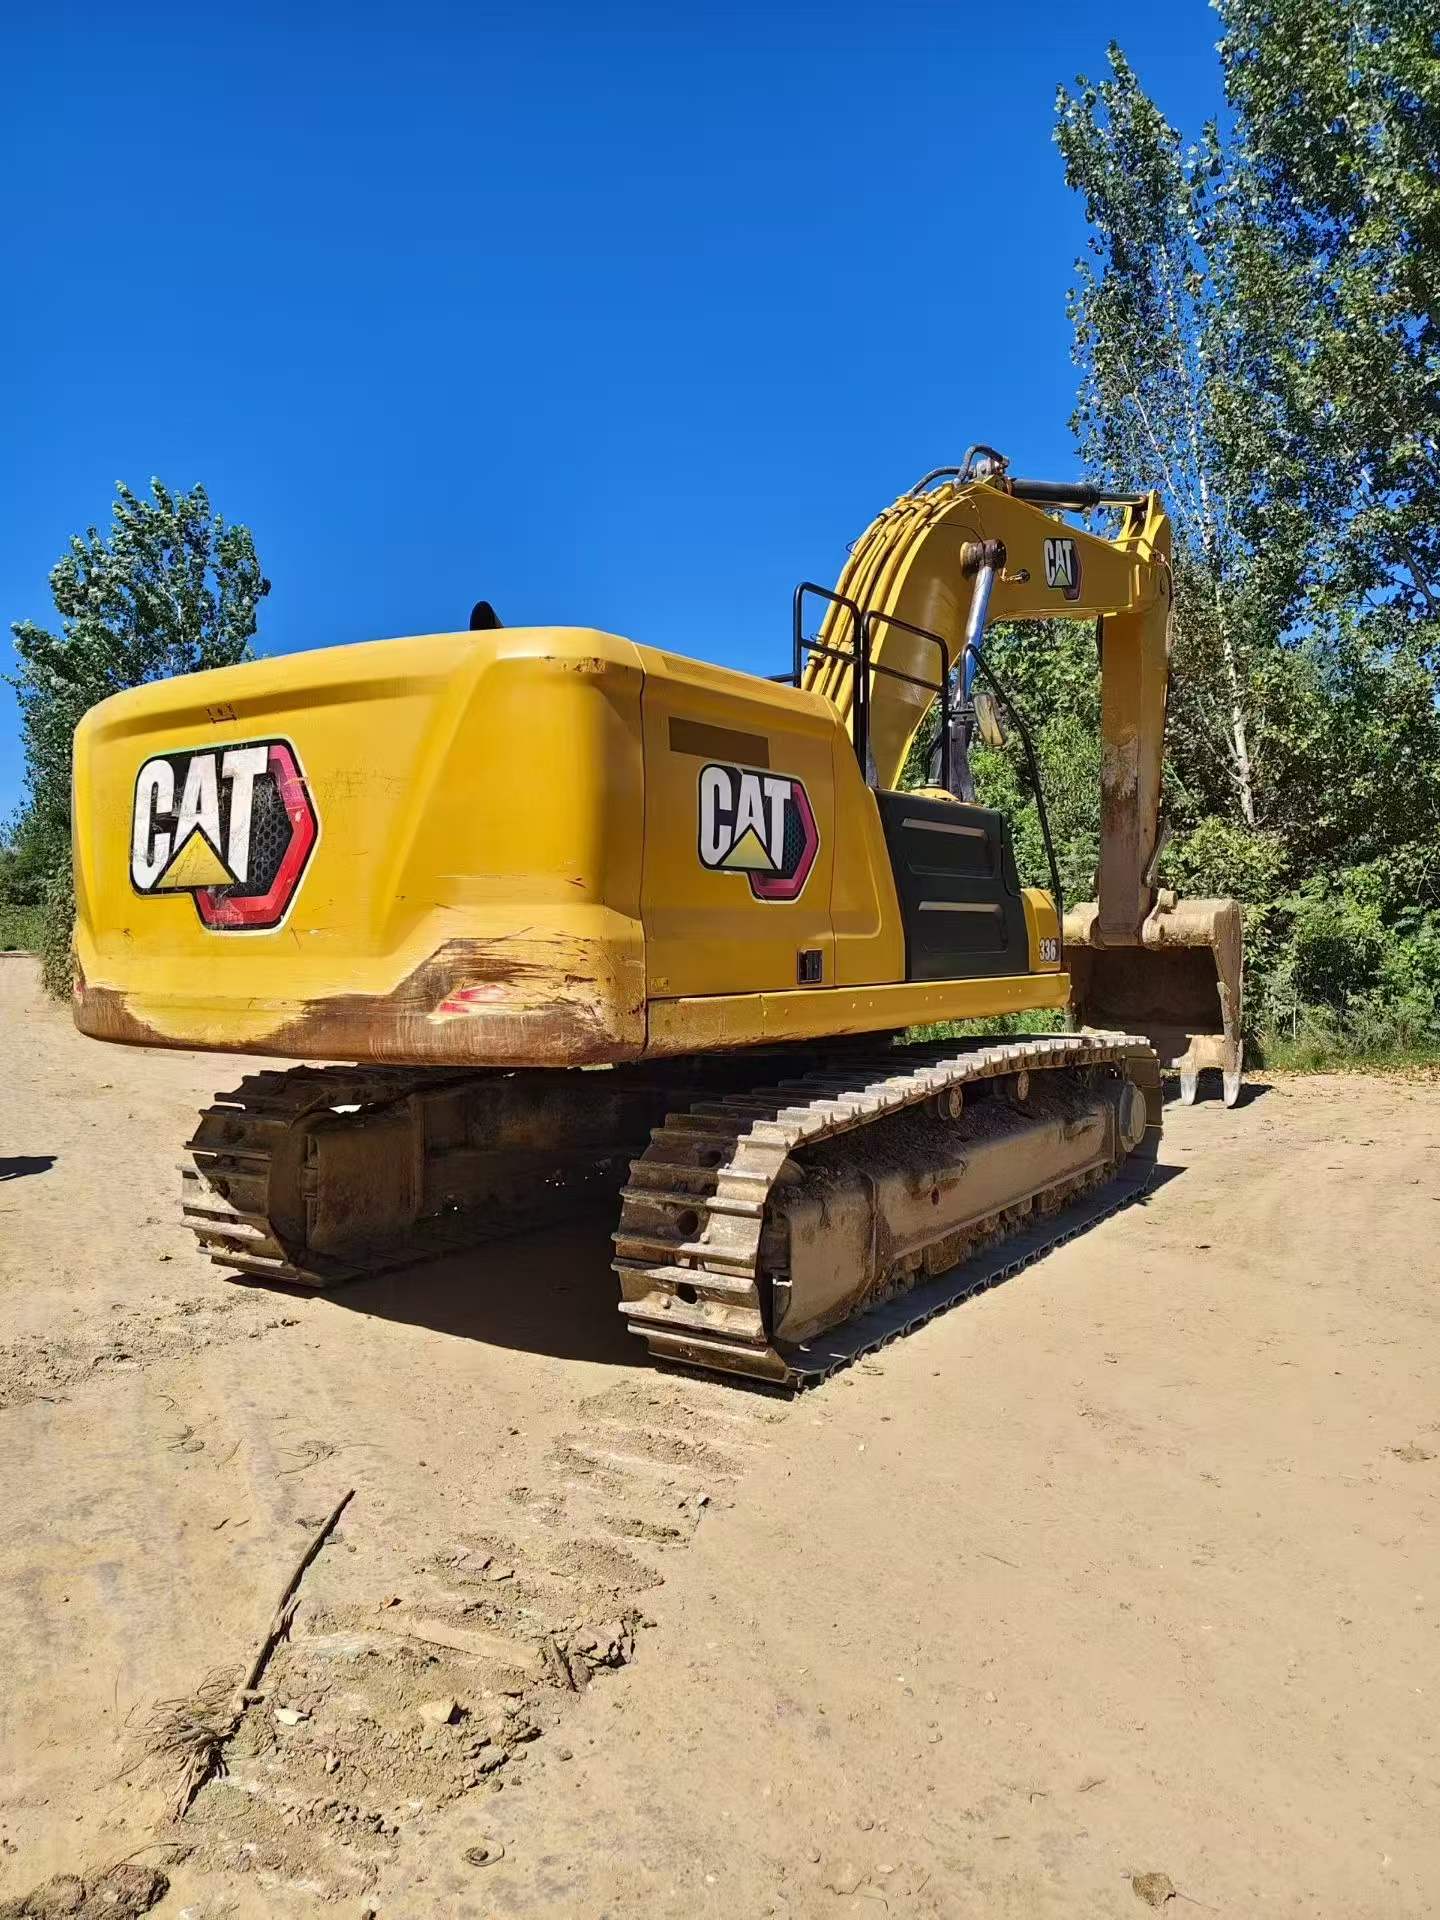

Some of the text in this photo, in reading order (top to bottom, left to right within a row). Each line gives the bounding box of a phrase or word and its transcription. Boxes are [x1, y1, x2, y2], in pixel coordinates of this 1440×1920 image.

[1044, 539, 1073, 587] CAT
[132, 746, 269, 889] CAT
[701, 766, 792, 870] CAT
[1039, 938, 1057, 961] 336
